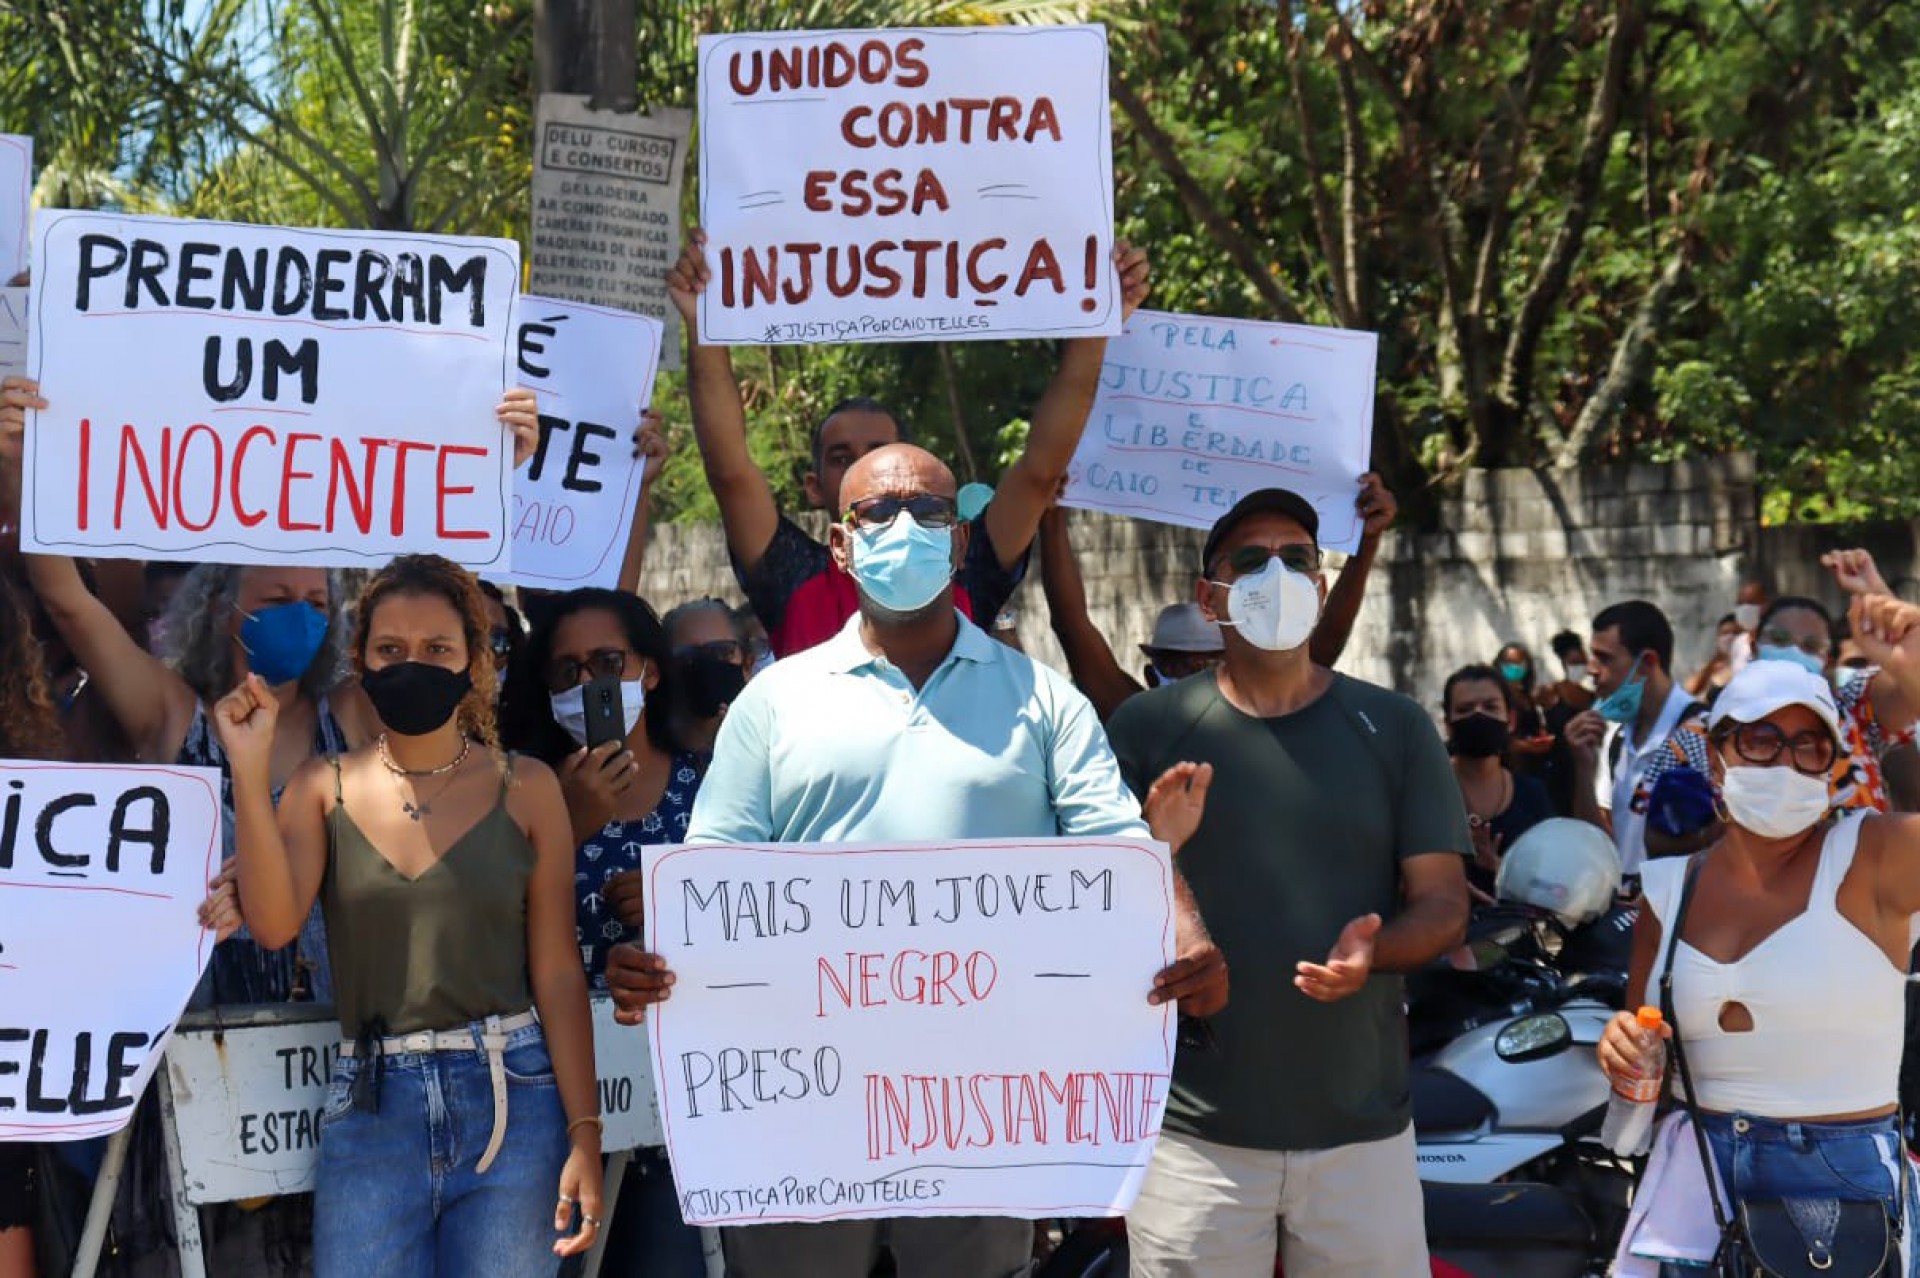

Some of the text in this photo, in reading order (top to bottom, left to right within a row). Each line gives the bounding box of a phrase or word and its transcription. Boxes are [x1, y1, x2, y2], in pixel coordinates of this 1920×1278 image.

[729, 38, 929, 96] UNIDOS
[549, 129, 670, 158] DELU CURSOS
[841, 96, 1062, 149] CONTRA
[551, 149, 663, 177] E CONSERTOS
[537, 197, 669, 225] AR CONDICIONADO
[560, 181, 648, 204] GELADEIRA
[803, 168, 949, 217] ESSA
[76, 234, 488, 327] PRENDERAM
[517, 315, 569, 378] É
[1151, 323, 1236, 351] PELA
[203, 335, 320, 405] UM
[1104, 413, 1312, 465] LIBERDADE
[77, 419, 490, 540] INOCENTE
[1087, 462, 1159, 496] CAIO
[513, 494, 575, 546] AIO
[682, 868, 1113, 946] MAIS UM JOVEM
[815, 948, 998, 1018] NEGRO
[0, 1024, 172, 1116] ELLE
[276, 1042, 341, 1090] TRI
[681, 1046, 842, 1119] PRESO
[863, 1070, 1170, 1161] INJUSTAMENTE
